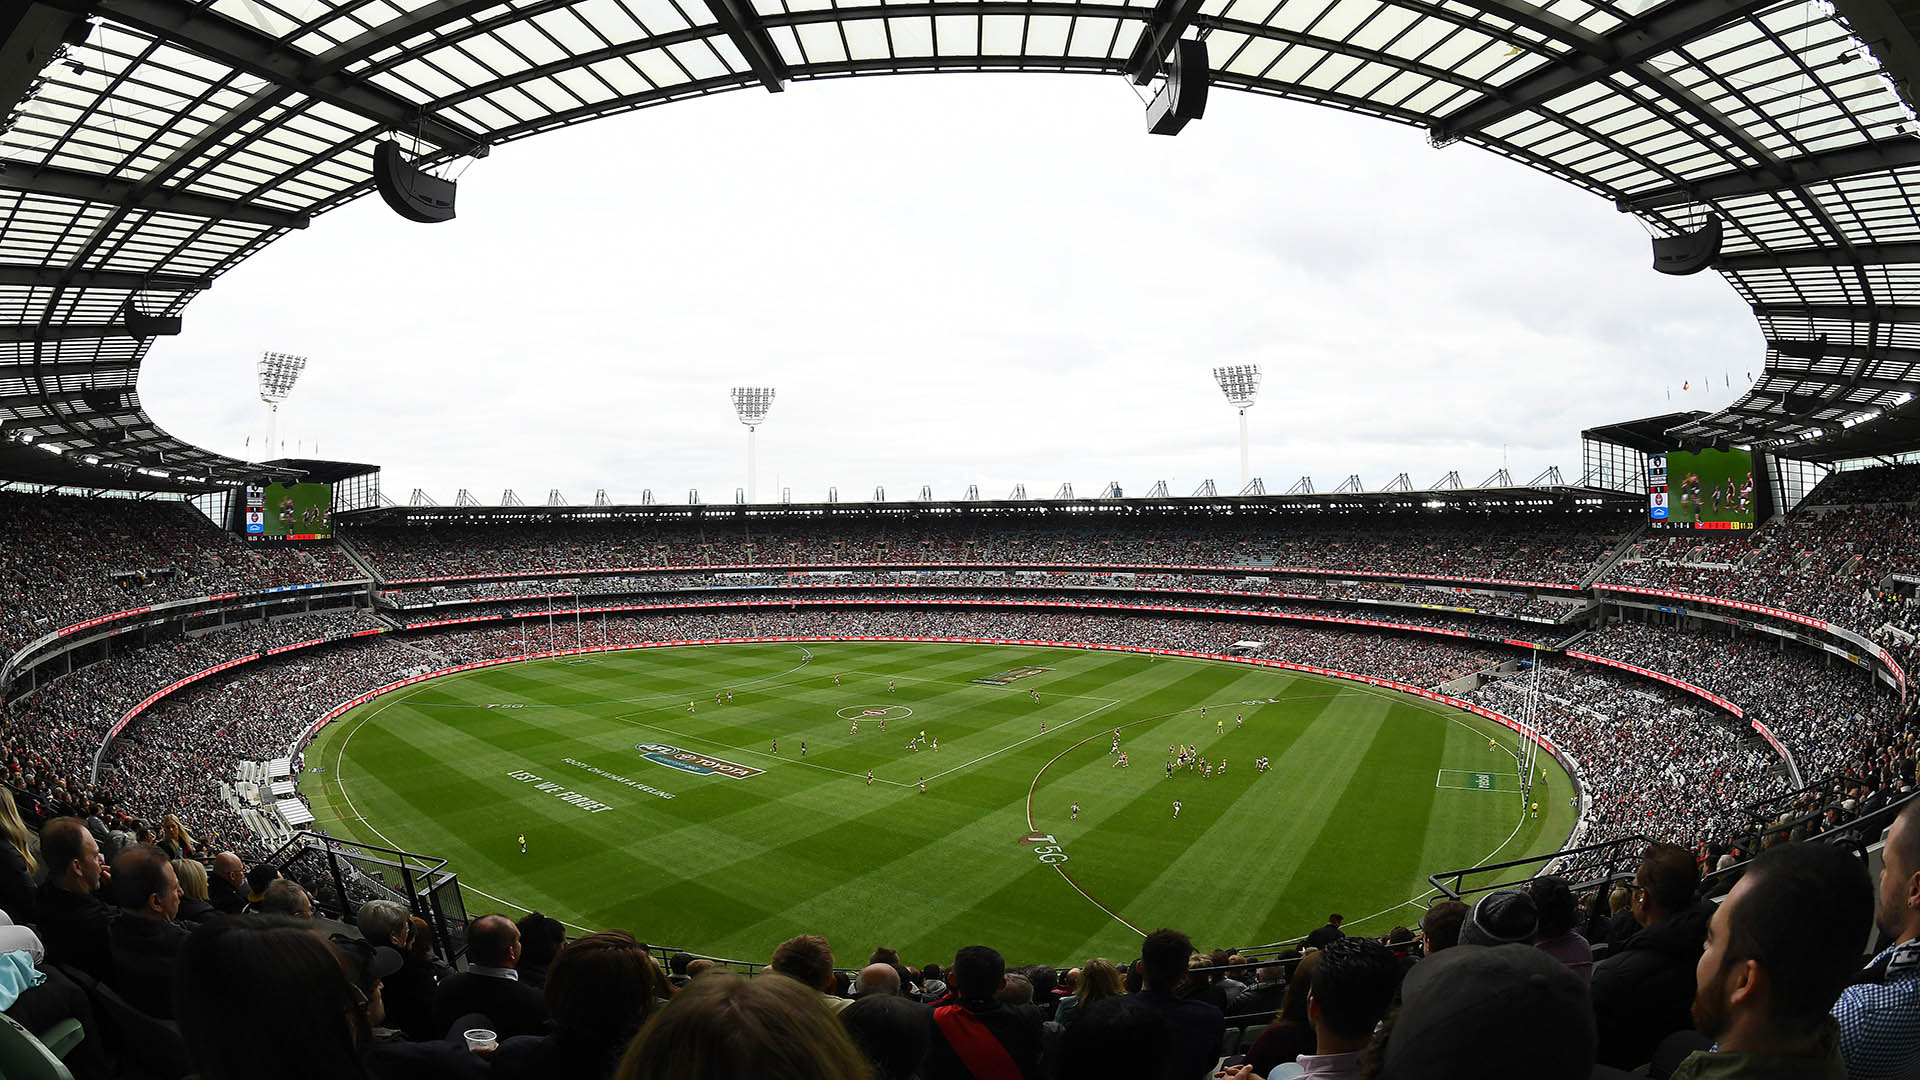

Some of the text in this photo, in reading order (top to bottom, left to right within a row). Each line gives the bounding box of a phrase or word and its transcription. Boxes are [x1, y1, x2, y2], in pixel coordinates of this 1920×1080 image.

[638, 744, 673, 755] AFL
[696, 758, 750, 776] TOYOTA
[506, 770, 614, 813] LEST WE FORGET
[633, 783, 676, 800] FEELING
